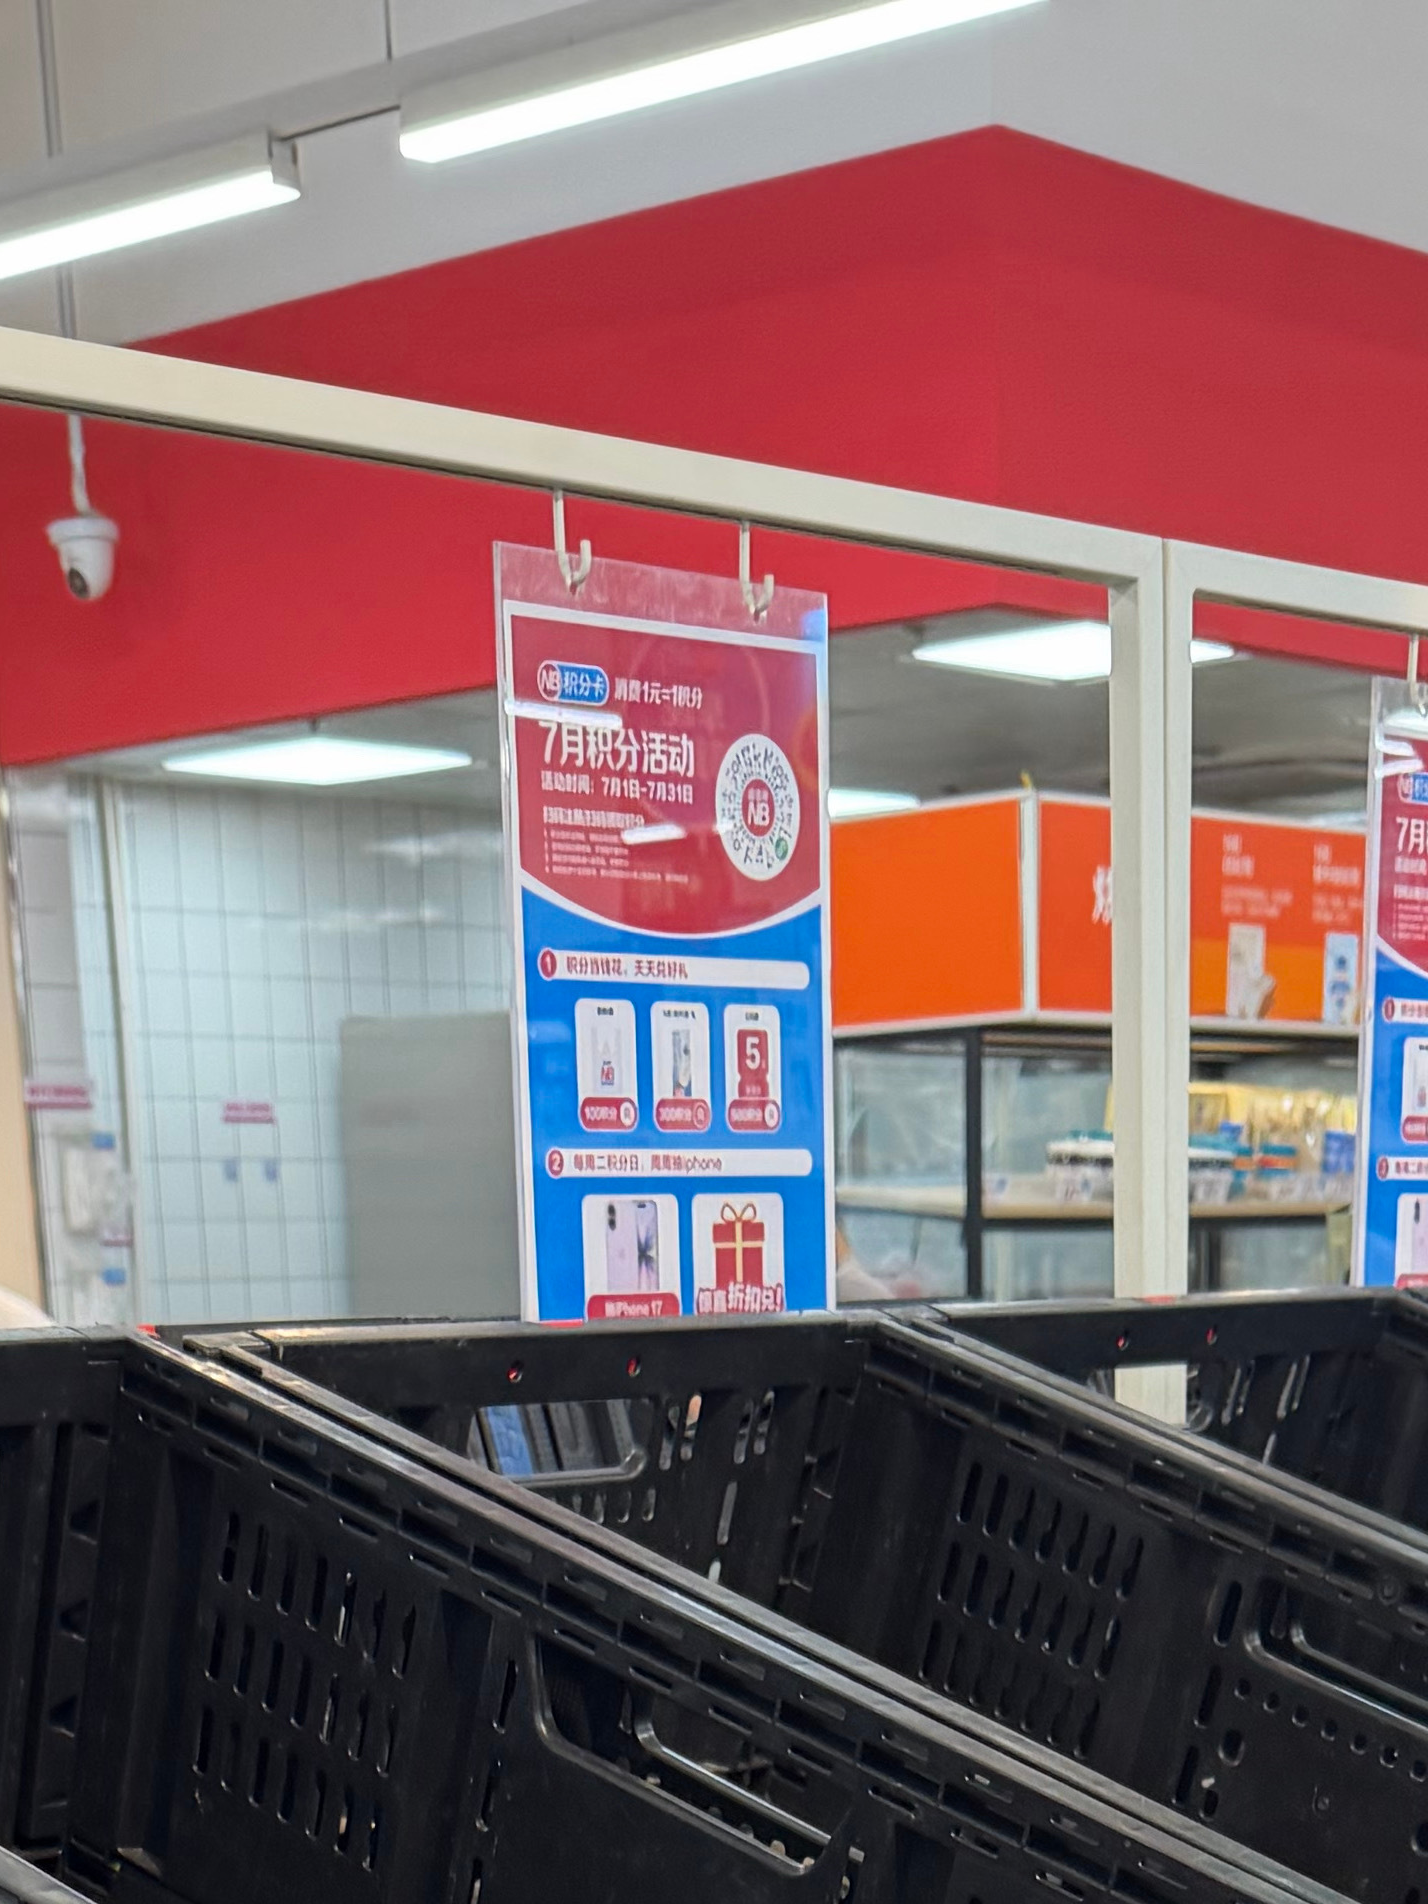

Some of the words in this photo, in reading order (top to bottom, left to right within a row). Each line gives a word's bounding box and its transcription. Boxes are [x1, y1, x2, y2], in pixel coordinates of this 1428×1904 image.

[563, 671, 605, 697] 积分卡
[538, 720, 694, 778] 7月积分活动
[748, 802, 770, 826] NB
[745, 1037, 760, 1070] 5
